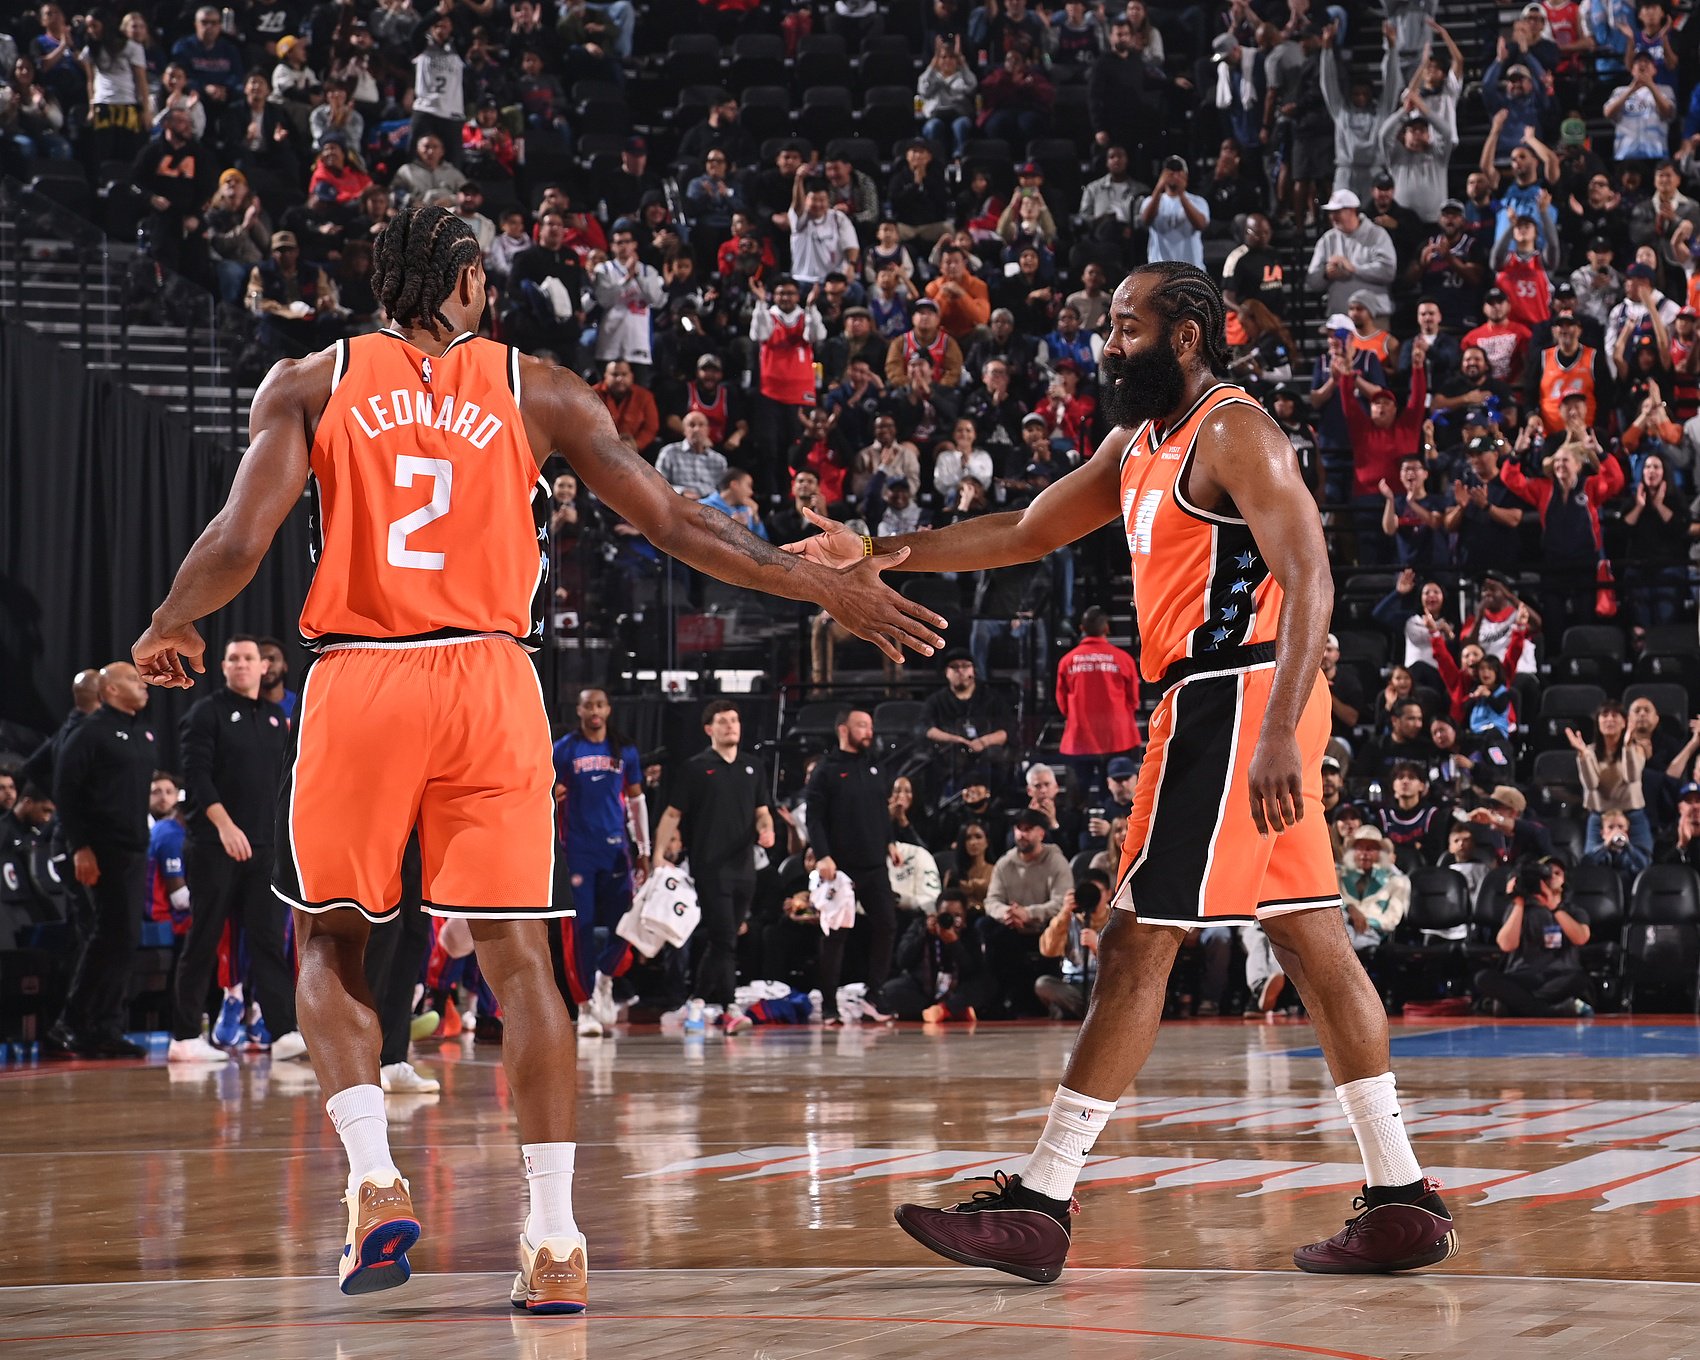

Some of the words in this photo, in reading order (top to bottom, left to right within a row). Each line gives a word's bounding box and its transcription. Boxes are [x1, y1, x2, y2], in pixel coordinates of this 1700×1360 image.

[434, 76, 448, 94] 2
[1263, 265, 1283, 282] LA
[351, 389, 502, 450] LEONARD
[1168, 446, 1182, 454] VISIT
[387, 454, 453, 570] 2
[665, 877, 680, 891] G
[673, 901, 689, 916] G
